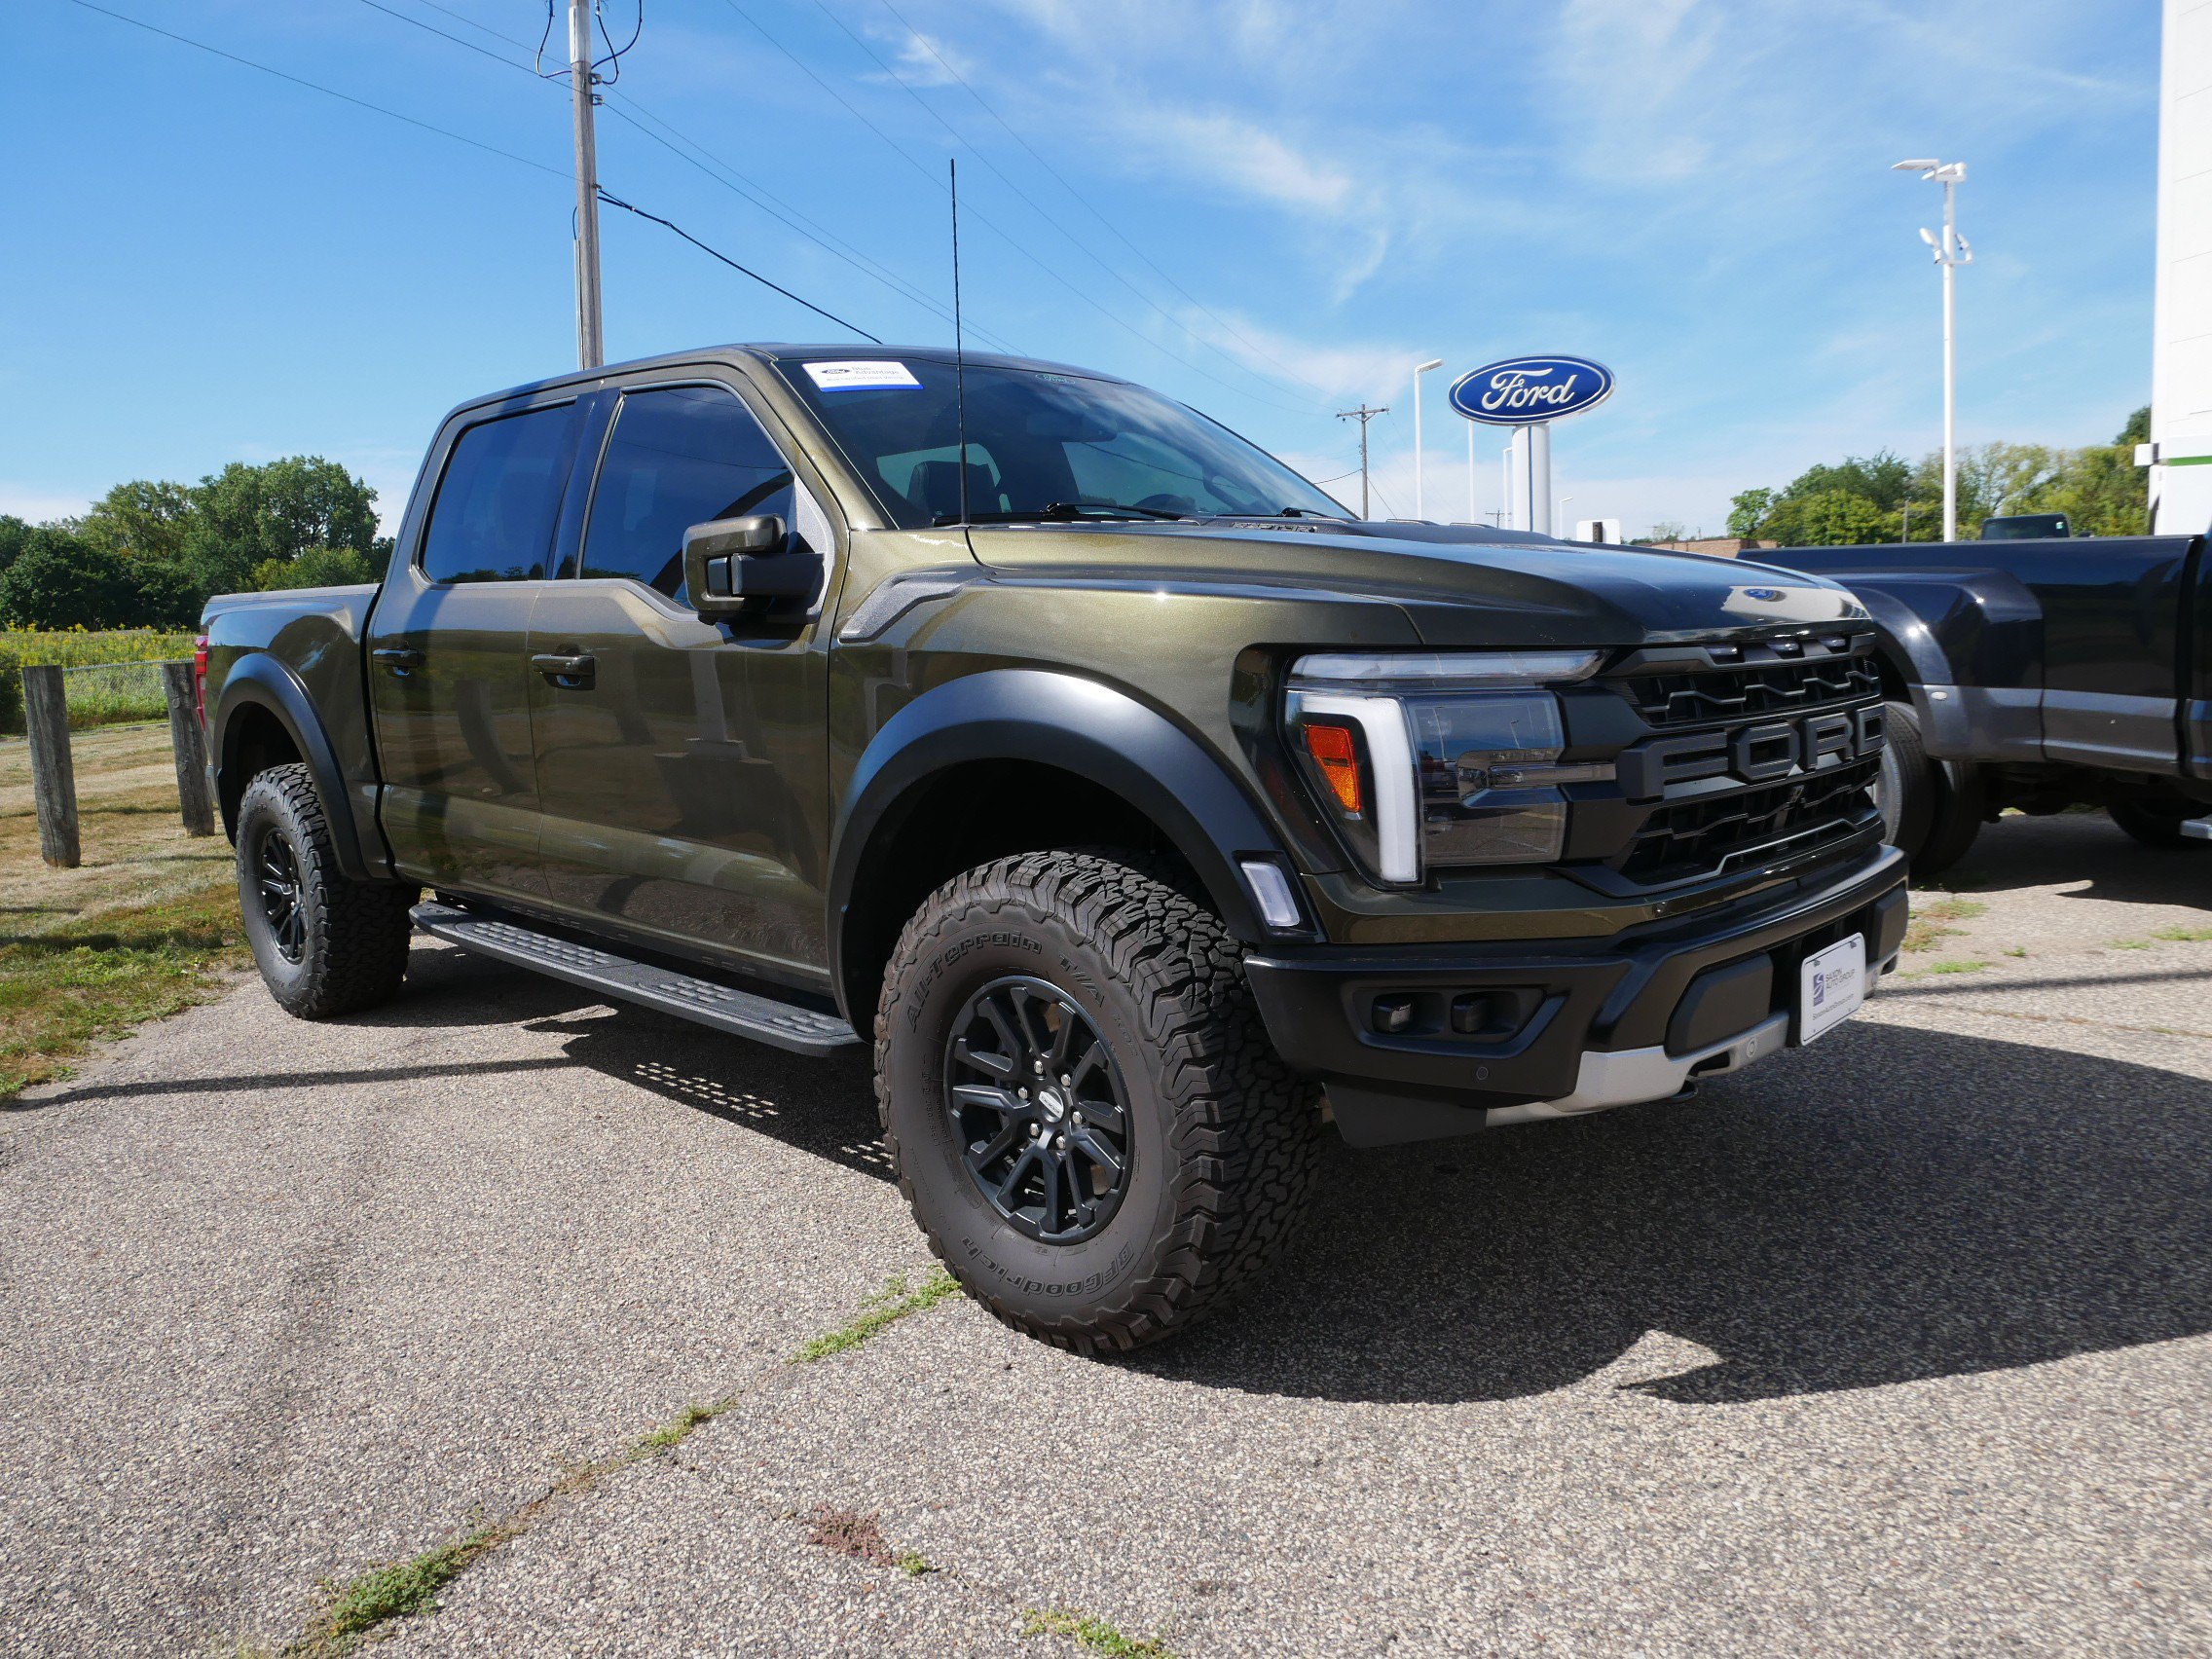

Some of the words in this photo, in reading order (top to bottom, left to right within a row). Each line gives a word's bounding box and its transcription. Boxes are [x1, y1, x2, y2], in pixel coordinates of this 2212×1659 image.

[1482, 367, 1579, 411] Ford
[1618, 702, 1886, 800] FORD
[906, 930, 1044, 1033] All-Terrain
[962, 1234, 1135, 1298] BFGoodrich
